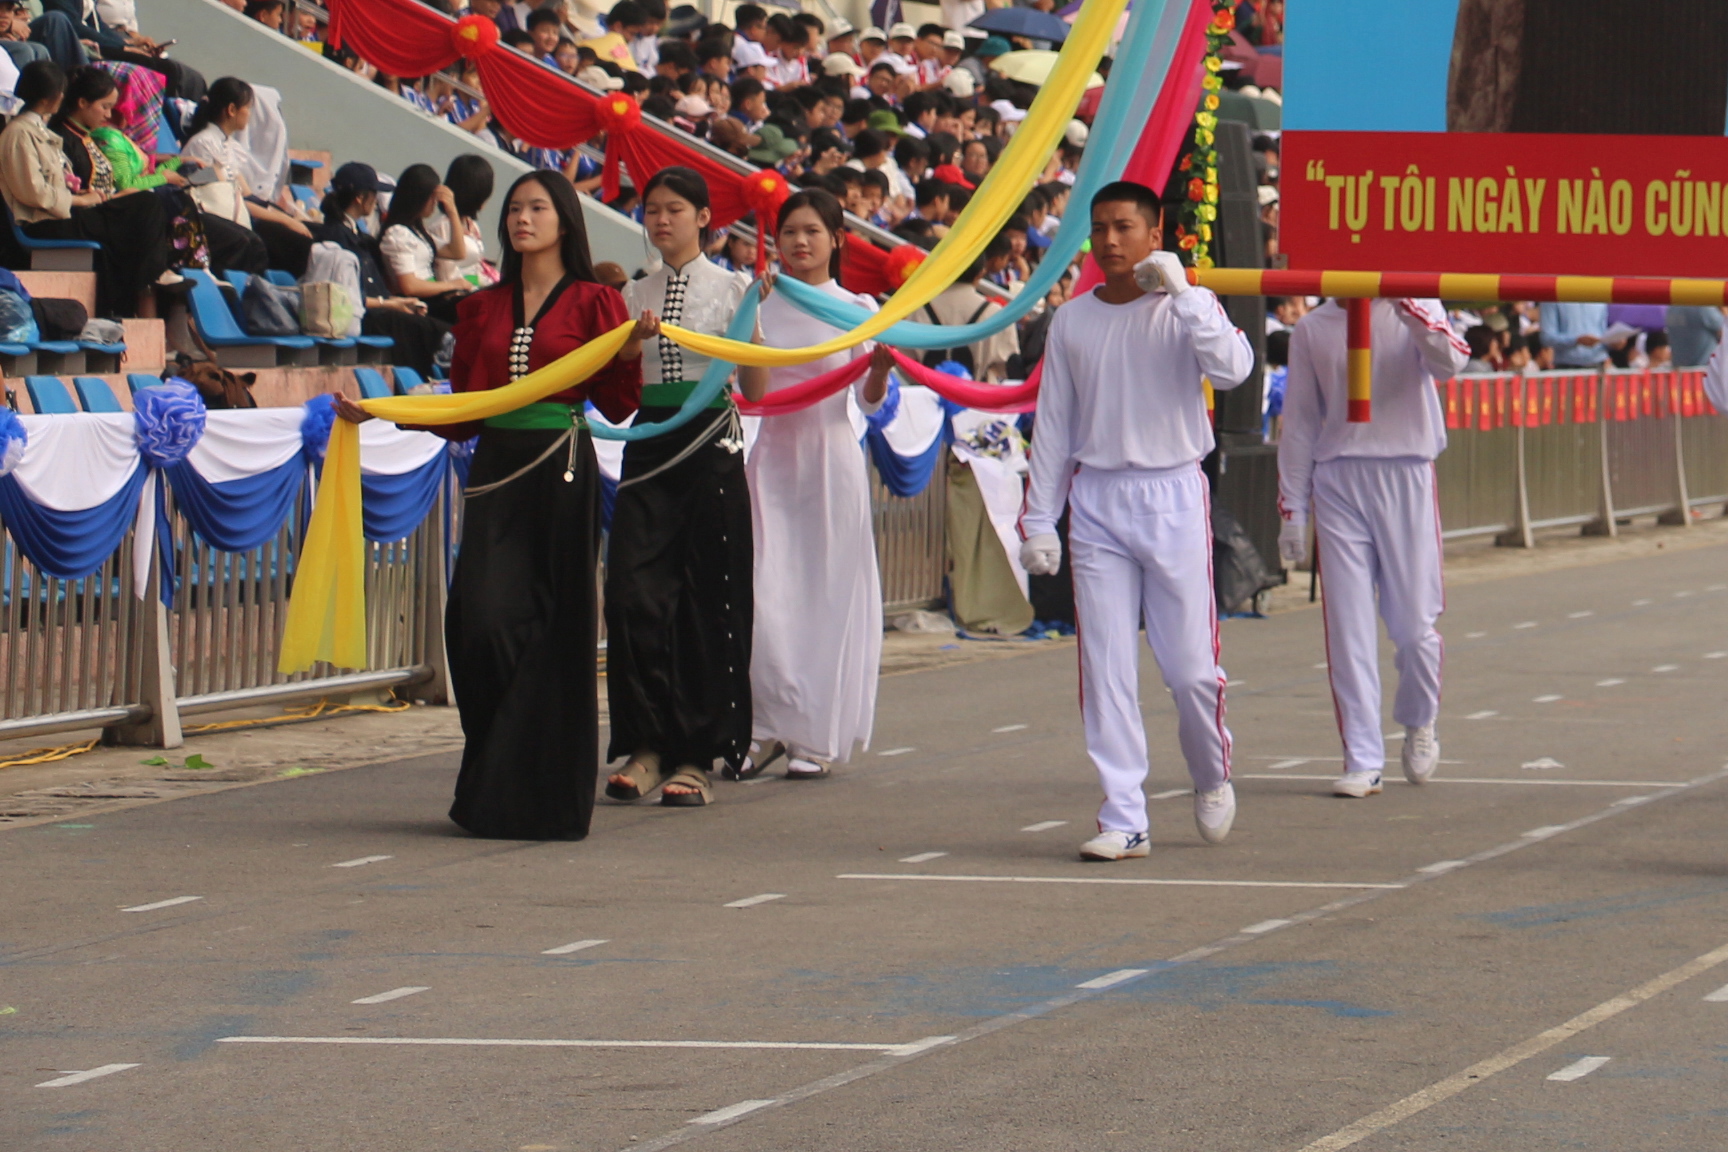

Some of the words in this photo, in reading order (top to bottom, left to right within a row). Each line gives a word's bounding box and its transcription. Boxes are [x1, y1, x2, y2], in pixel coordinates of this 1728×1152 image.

[1379, 164, 1436, 232] TÔI
[1447, 165, 1547, 234] NGÀY
[1556, 167, 1633, 236] NÀO
